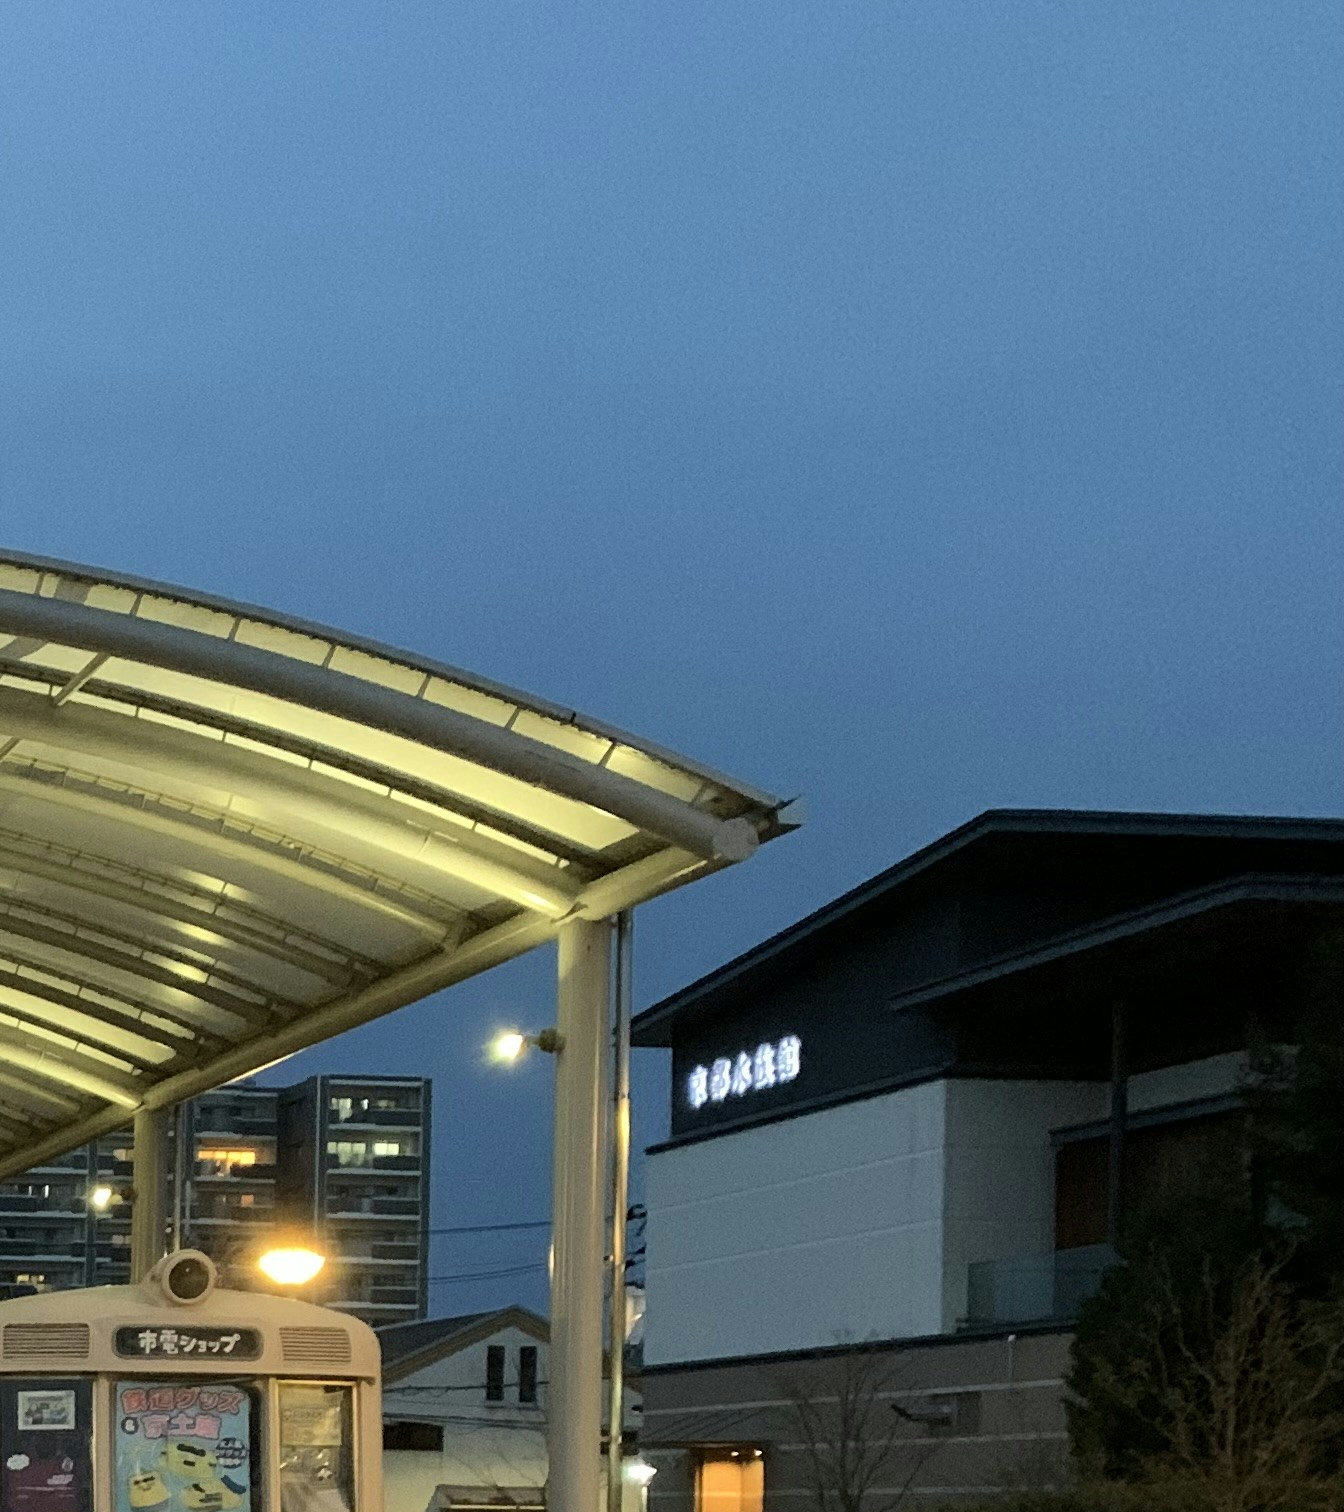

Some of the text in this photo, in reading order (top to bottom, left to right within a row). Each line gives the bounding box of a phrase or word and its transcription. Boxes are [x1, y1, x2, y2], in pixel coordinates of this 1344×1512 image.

[138, 1329, 241, 1355] 市電ショップ
